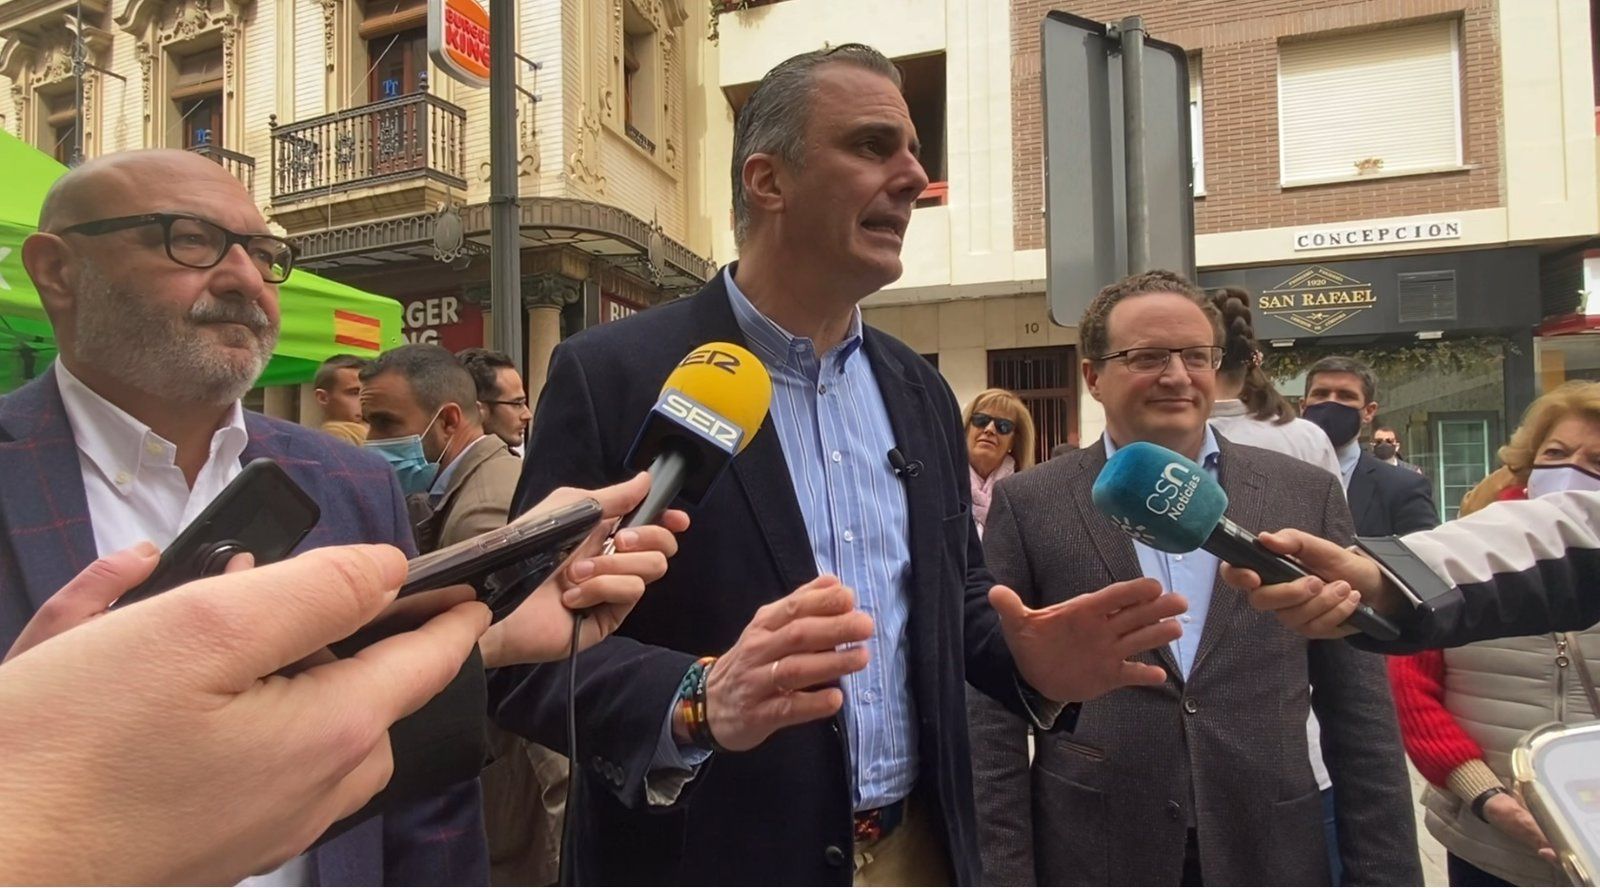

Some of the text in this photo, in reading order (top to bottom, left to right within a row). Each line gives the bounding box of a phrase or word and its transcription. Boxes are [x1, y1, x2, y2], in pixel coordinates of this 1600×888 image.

[1297, 223, 1459, 248] CONCEPCION
[1307, 279, 1327, 287] 1920
[1259, 289, 1377, 309] SAN RAFAEL
[402, 296, 459, 328] GER
[1025, 322, 1040, 334] 10
[662, 394, 738, 448] SER
[1167, 474, 1201, 521] Noticias
